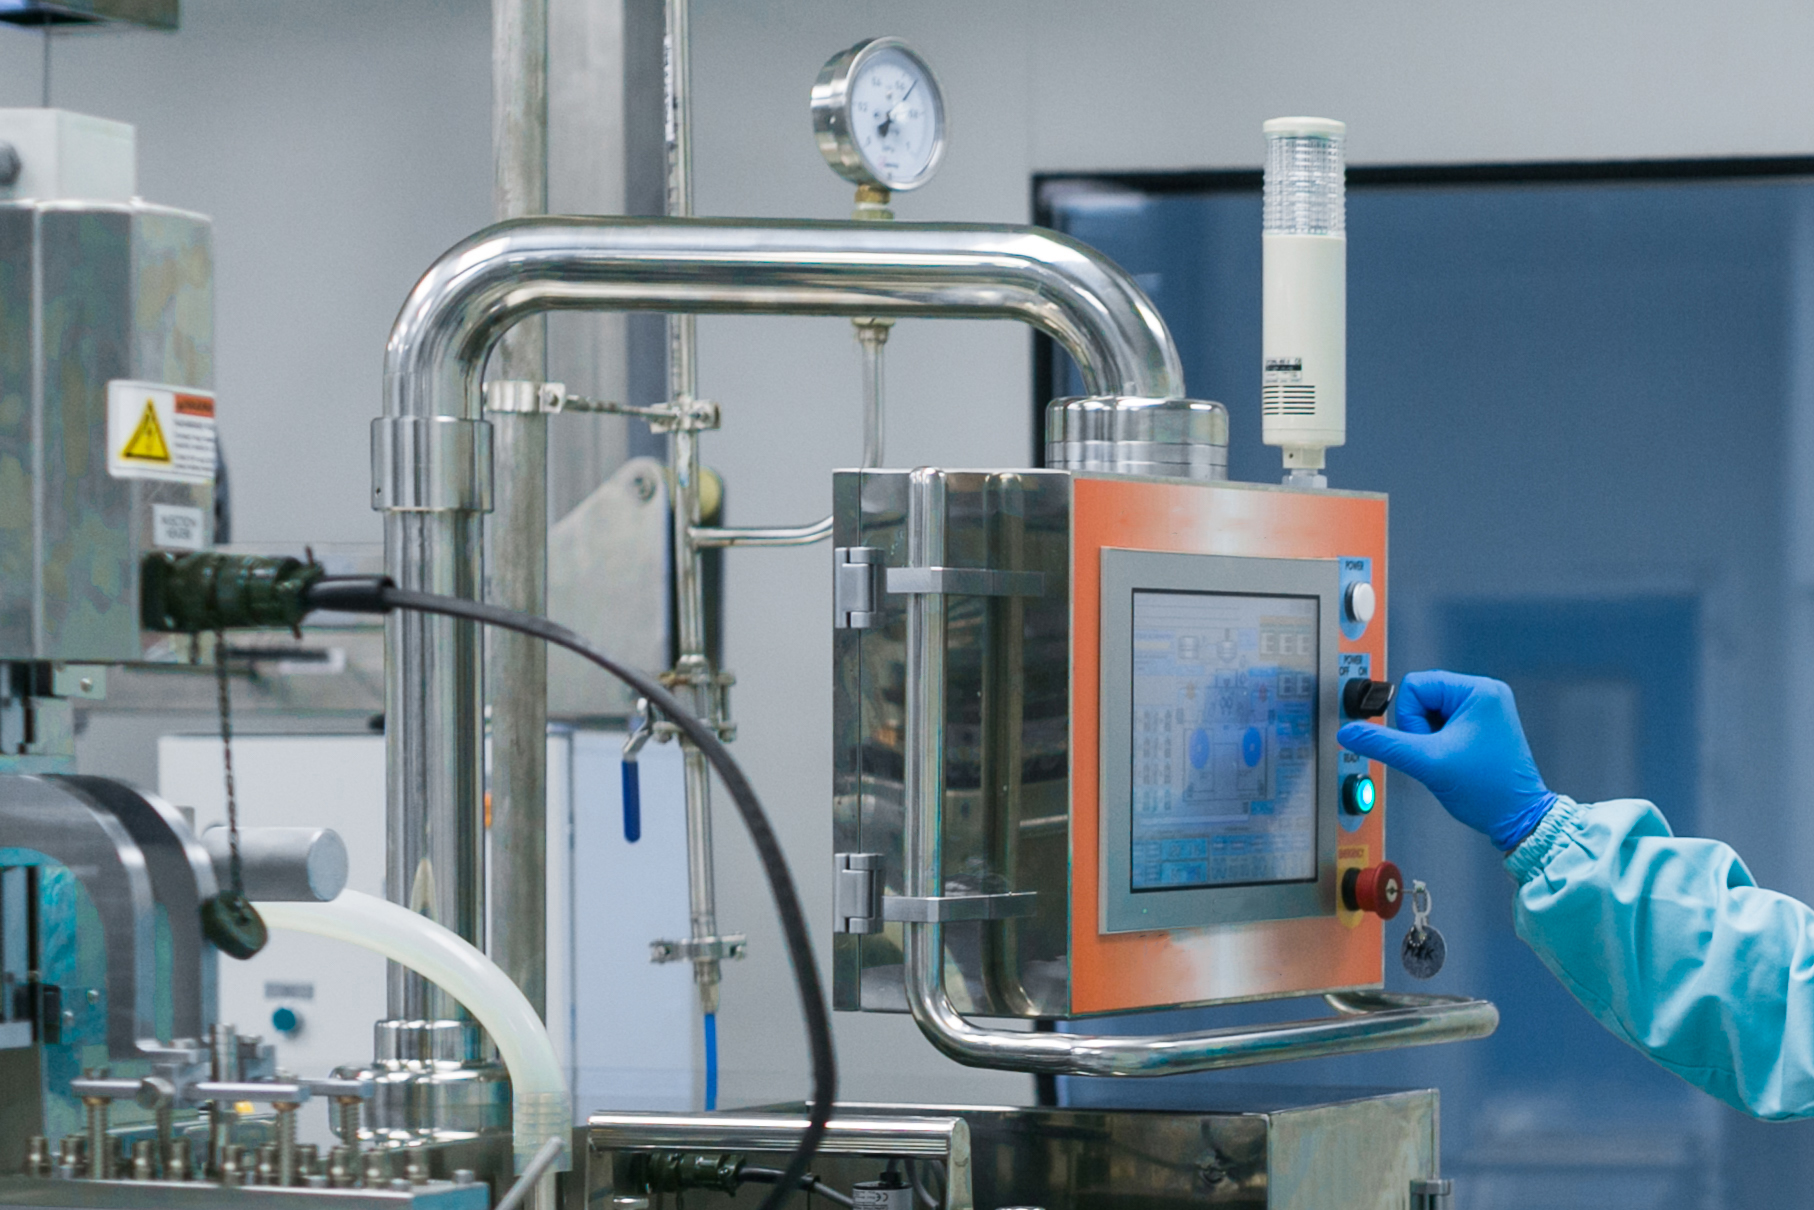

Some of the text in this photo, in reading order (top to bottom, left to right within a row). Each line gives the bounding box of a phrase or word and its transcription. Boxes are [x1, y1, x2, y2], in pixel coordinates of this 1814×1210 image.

[1345, 561, 1364, 571] POWER
[1344, 655, 1363, 665] POWER
[1340, 667, 1349, 676] OFF
[1358, 666, 1368, 676] ON
